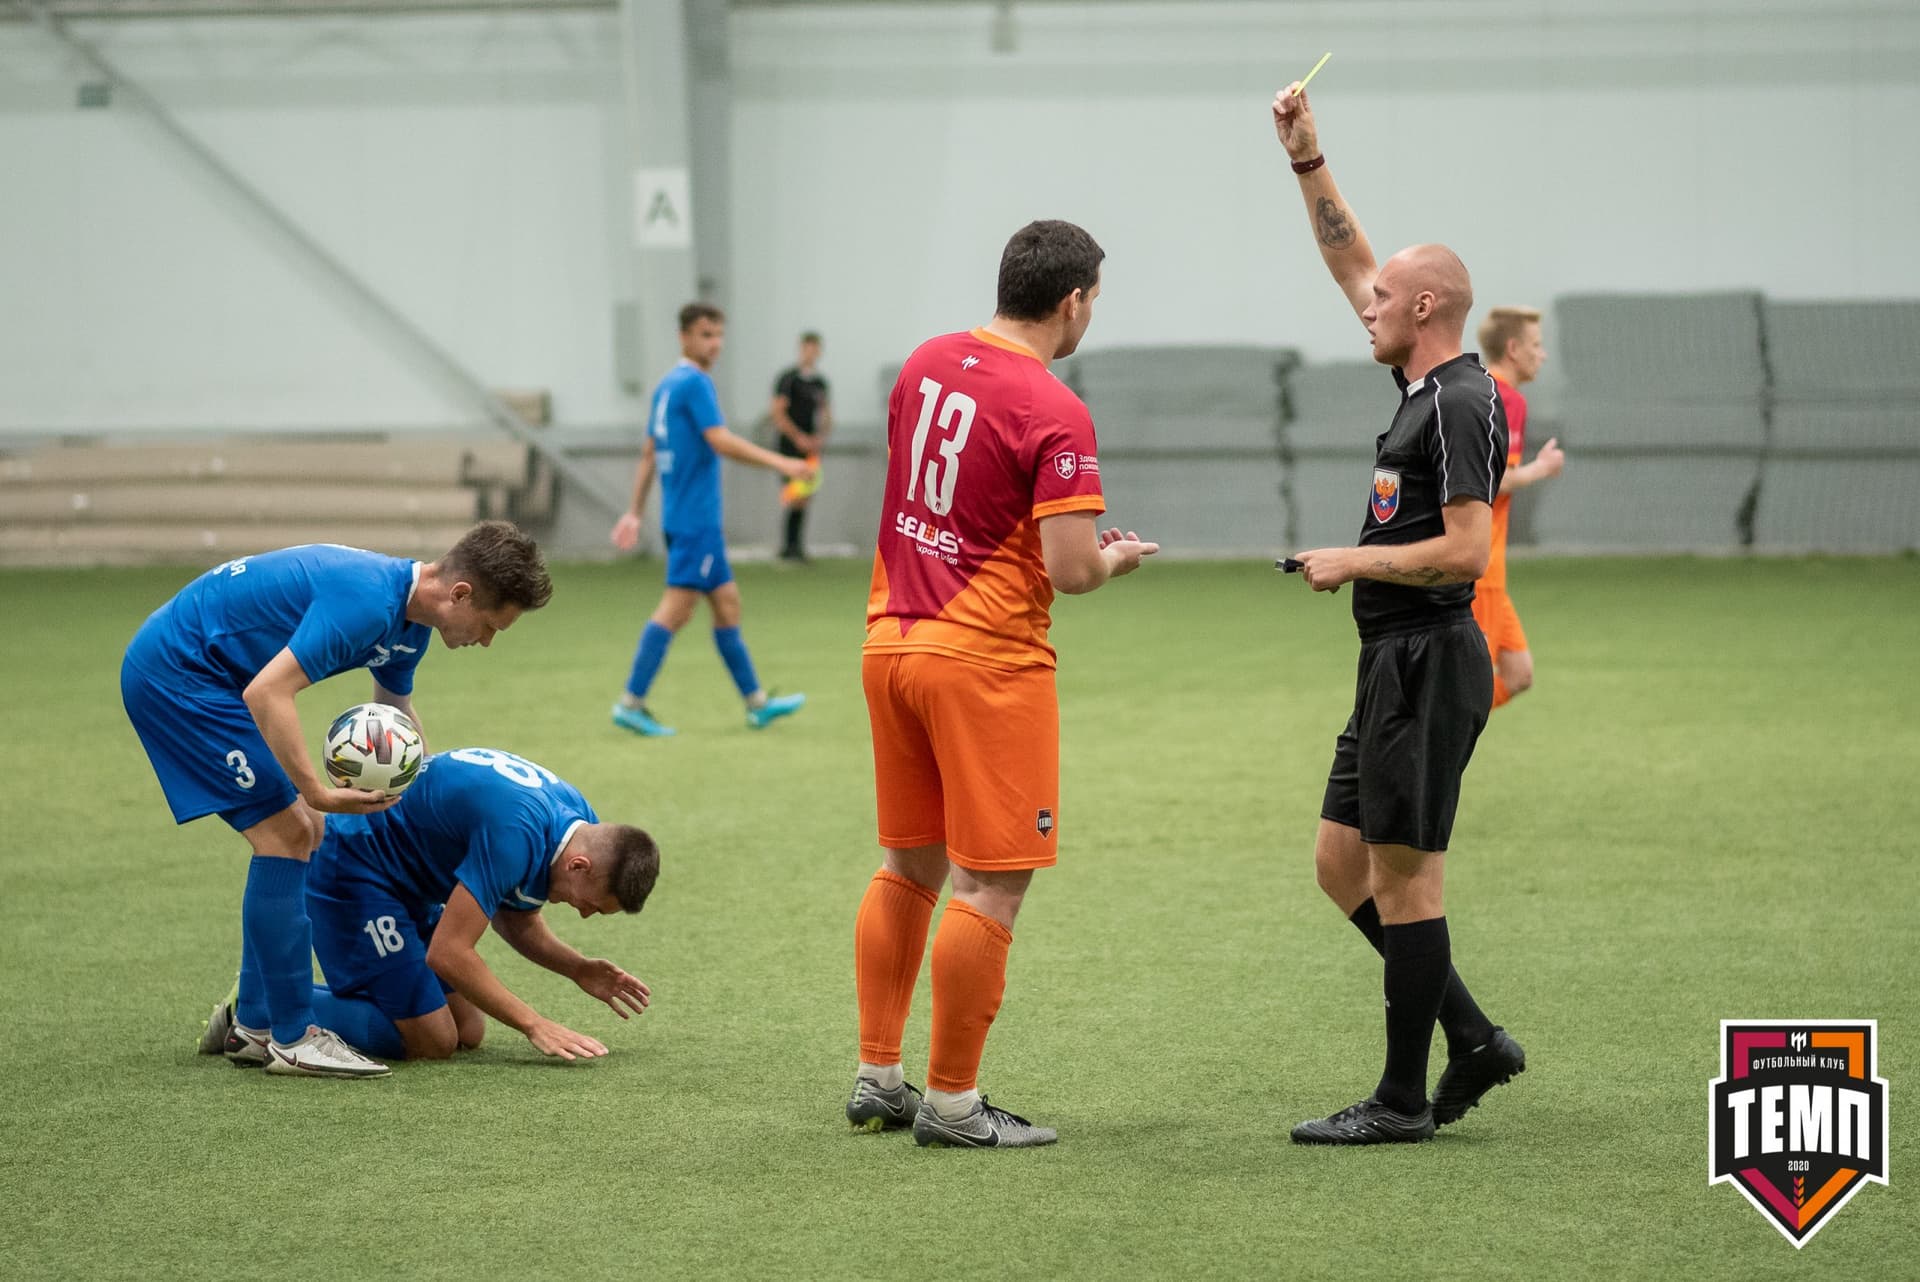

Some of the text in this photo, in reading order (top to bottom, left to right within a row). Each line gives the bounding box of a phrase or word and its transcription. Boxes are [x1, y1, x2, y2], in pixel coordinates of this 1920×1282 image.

[906, 376, 977, 517] 13
[226, 749, 256, 789] 3
[363, 915, 405, 958] 18
